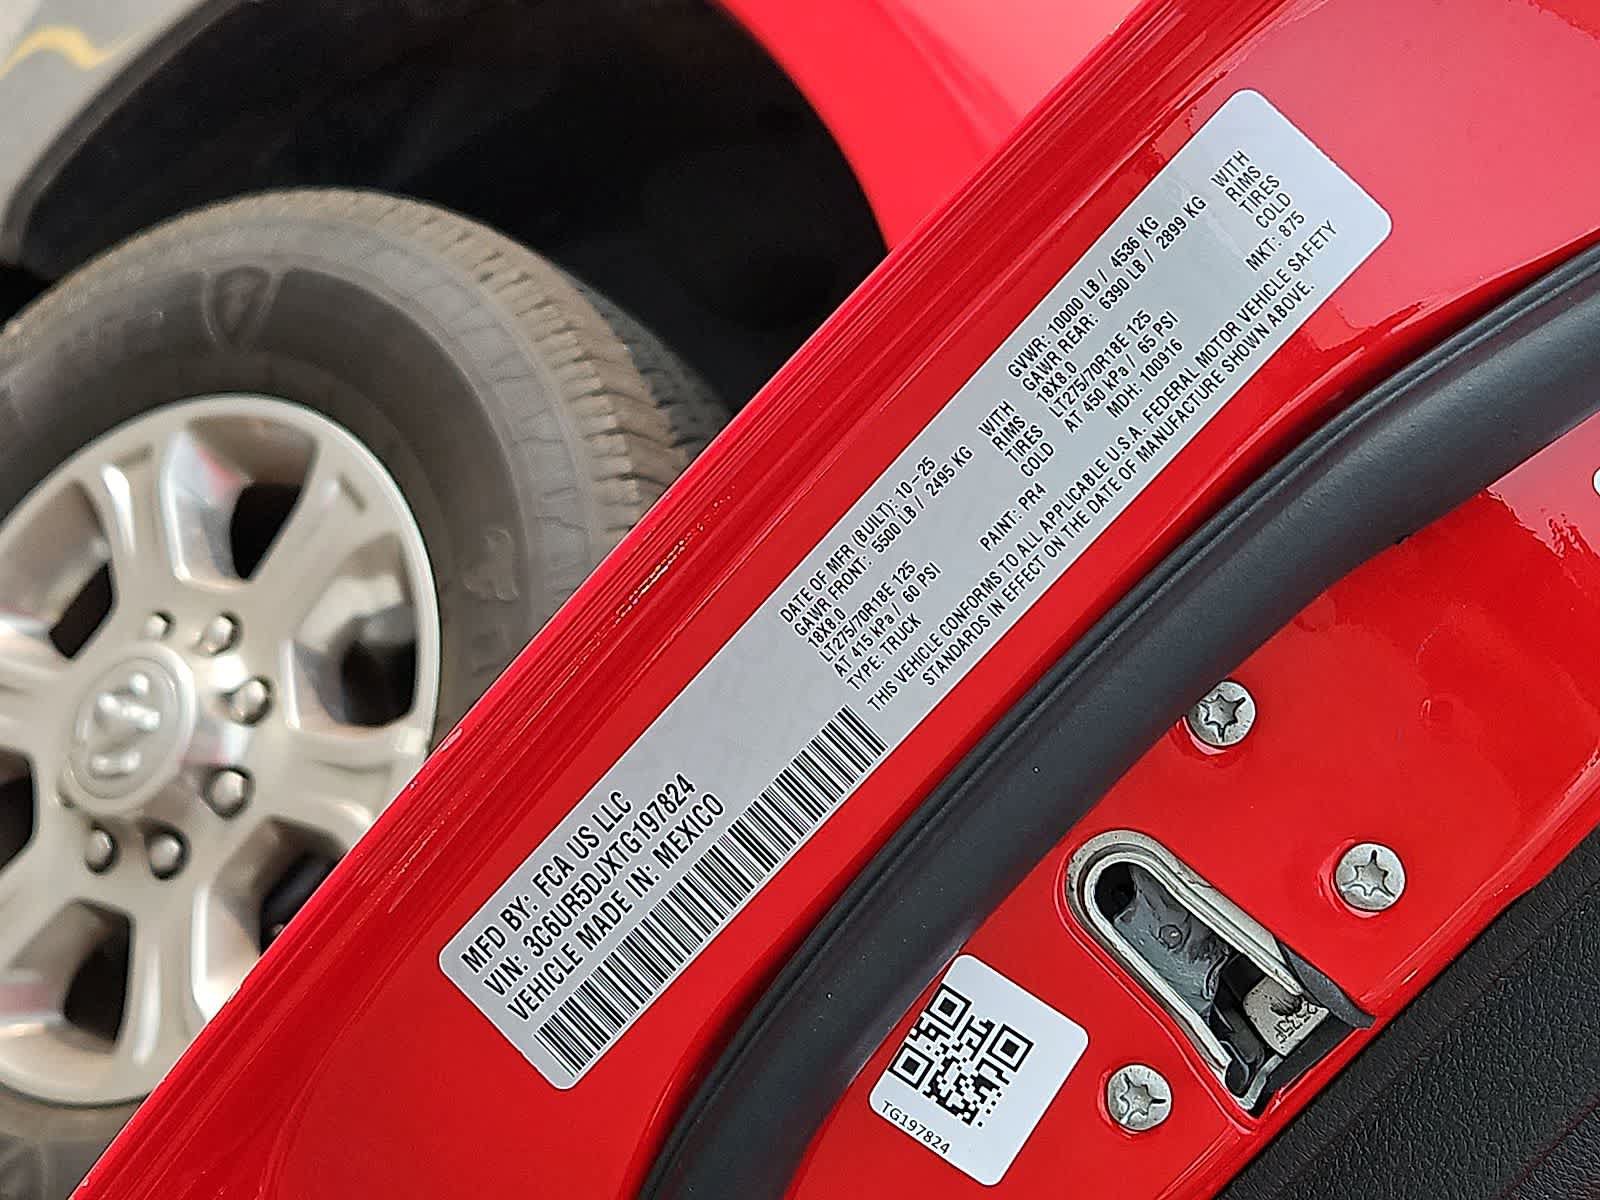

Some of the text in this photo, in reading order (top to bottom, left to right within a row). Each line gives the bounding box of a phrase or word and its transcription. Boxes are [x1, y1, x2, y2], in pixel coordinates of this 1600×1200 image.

[1210, 150, 1250, 187] WITH
[1225, 165, 1261, 202] RIMS
[1238, 174, 1279, 213] TIRES
[1245, 210, 1304, 271] MKT: 875
[1255, 192, 1291, 228] COLD
[1008, 335, 1051, 377] GVWR:
[1047, 297, 1084, 334] 10000
[1079, 278, 1100, 299] LB
[1110, 236, 1140, 267] 4536
[1136, 216, 1159, 239] KG
[1022, 350, 1062, 391] GAWR
[1057, 313, 1098, 354] REAR:
[1098, 277, 1130, 309] 6390
[1125, 259, 1146, 280] LB
[1155, 216, 1187, 249] 2899
[1182, 196, 1206, 218] KG
[1036, 361, 1077, 403] 18X8.0
[1048, 309, 1151, 418] LT275/70R18E 125
[1064, 409, 1083, 433] AT
[1082, 387, 1106, 412] 450
[1101, 366, 1129, 391] kPa
[1137, 333, 1156, 354] 65
[1152, 310, 1178, 337] PSI
[1106, 338, 1182, 418] MDH: 100916
[978, 400, 1015, 436] WITH
[991, 415, 1026, 451] RIMS
[1004, 424, 1043, 463] TIRES
[866, 219, 1336, 711] THIS VEHICLE CONFORMS TO ALL APPLICABLE U.S.A. FEDERAL MOTOR VEHICLE SAFETY
[922, 280, 1314, 686] STANDARDS IN EFFECT ON THE DATE OF MANUFACTURE SHOWN ABOVE.
[1020, 442, 1054, 477] COLD
[779, 456, 935, 623] DATE OF MFR (BUILT): 10-25
[794, 597, 832, 636] GAWR
[827, 555, 872, 600] FRONT:
[870, 522, 901, 553] 5500
[897, 505, 917, 525] LB
[925, 463, 955, 497] 2495
[951, 446, 973, 468] KG
[979, 482, 1046, 551] PAINT: PR4
[807, 607, 846, 648] 18X8.0
[819, 560, 915, 662] LT275/70R18E 125
[834, 654, 852, 677] AT
[851, 633, 874, 657] 415
[868, 614, 895, 638] kPa
[902, 584, 920, 602] 60
[916, 562, 941, 587] PSI
[846, 612, 921, 690] TYPE: TRUCK
[460, 791, 631, 973] MFD BY: FCA US LLC
[483, 773, 695, 995] VIN: 3C6UR5DJXTG197824
[507, 793, 724, 1020] VEHICLE MADE IN: MEXICO
[882, 1100, 951, 1155] TG197824
